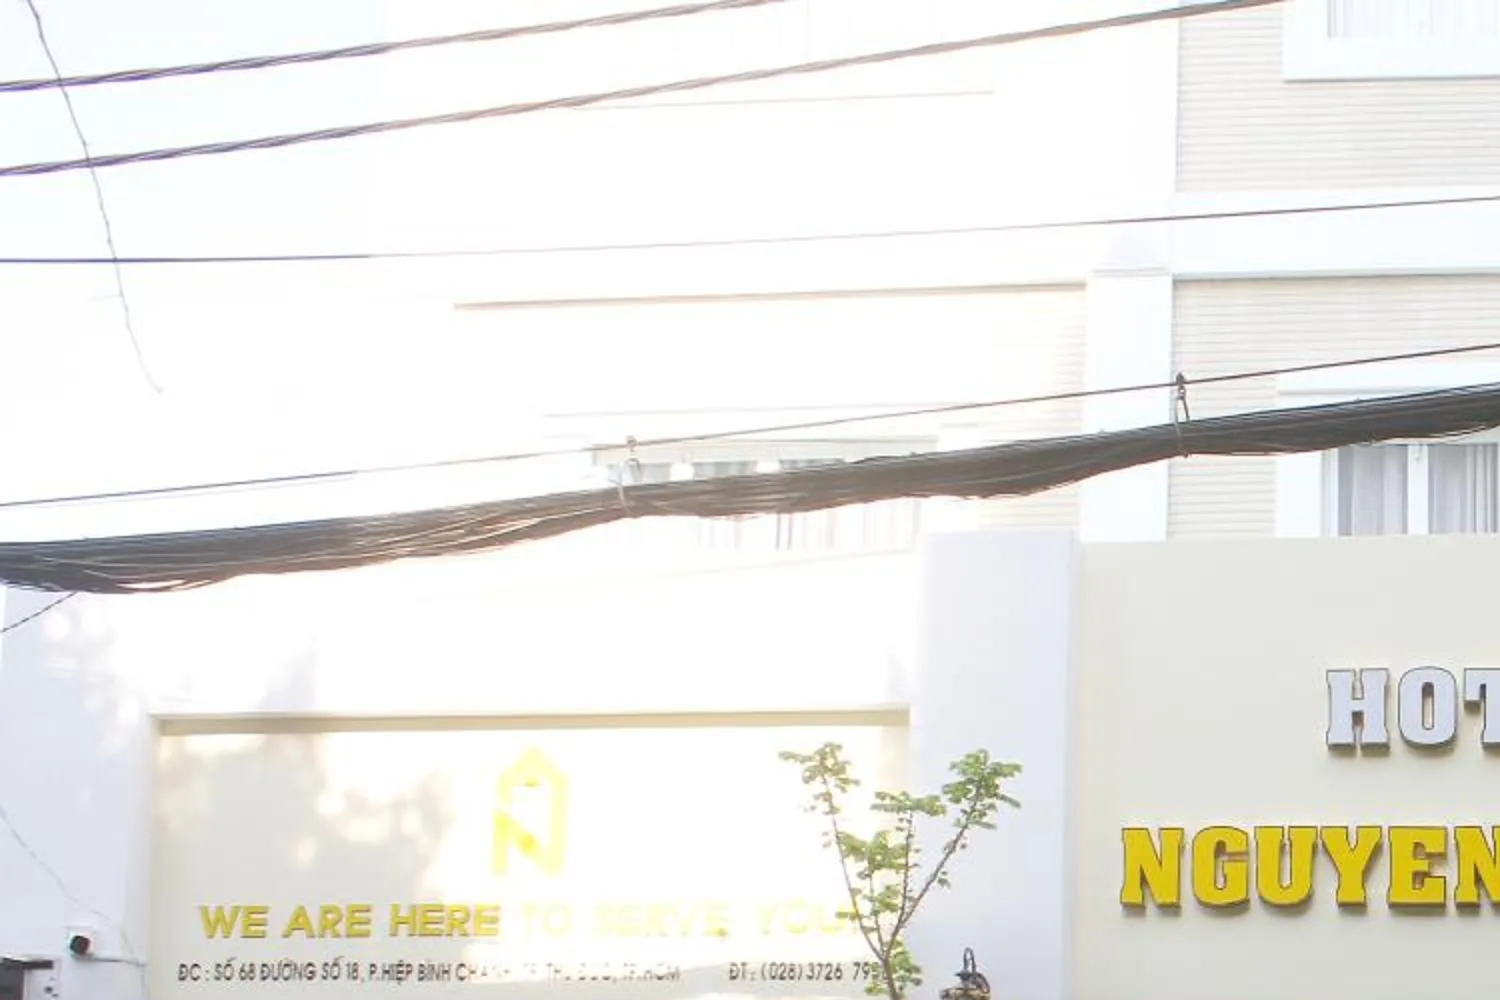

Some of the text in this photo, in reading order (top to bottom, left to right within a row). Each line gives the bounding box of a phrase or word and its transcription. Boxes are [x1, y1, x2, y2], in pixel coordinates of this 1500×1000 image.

[199, 903, 270, 938] WE
[281, 903, 372, 938] ARE
[388, 902, 500, 938] HERE
[238, 963, 257, 981] 68
